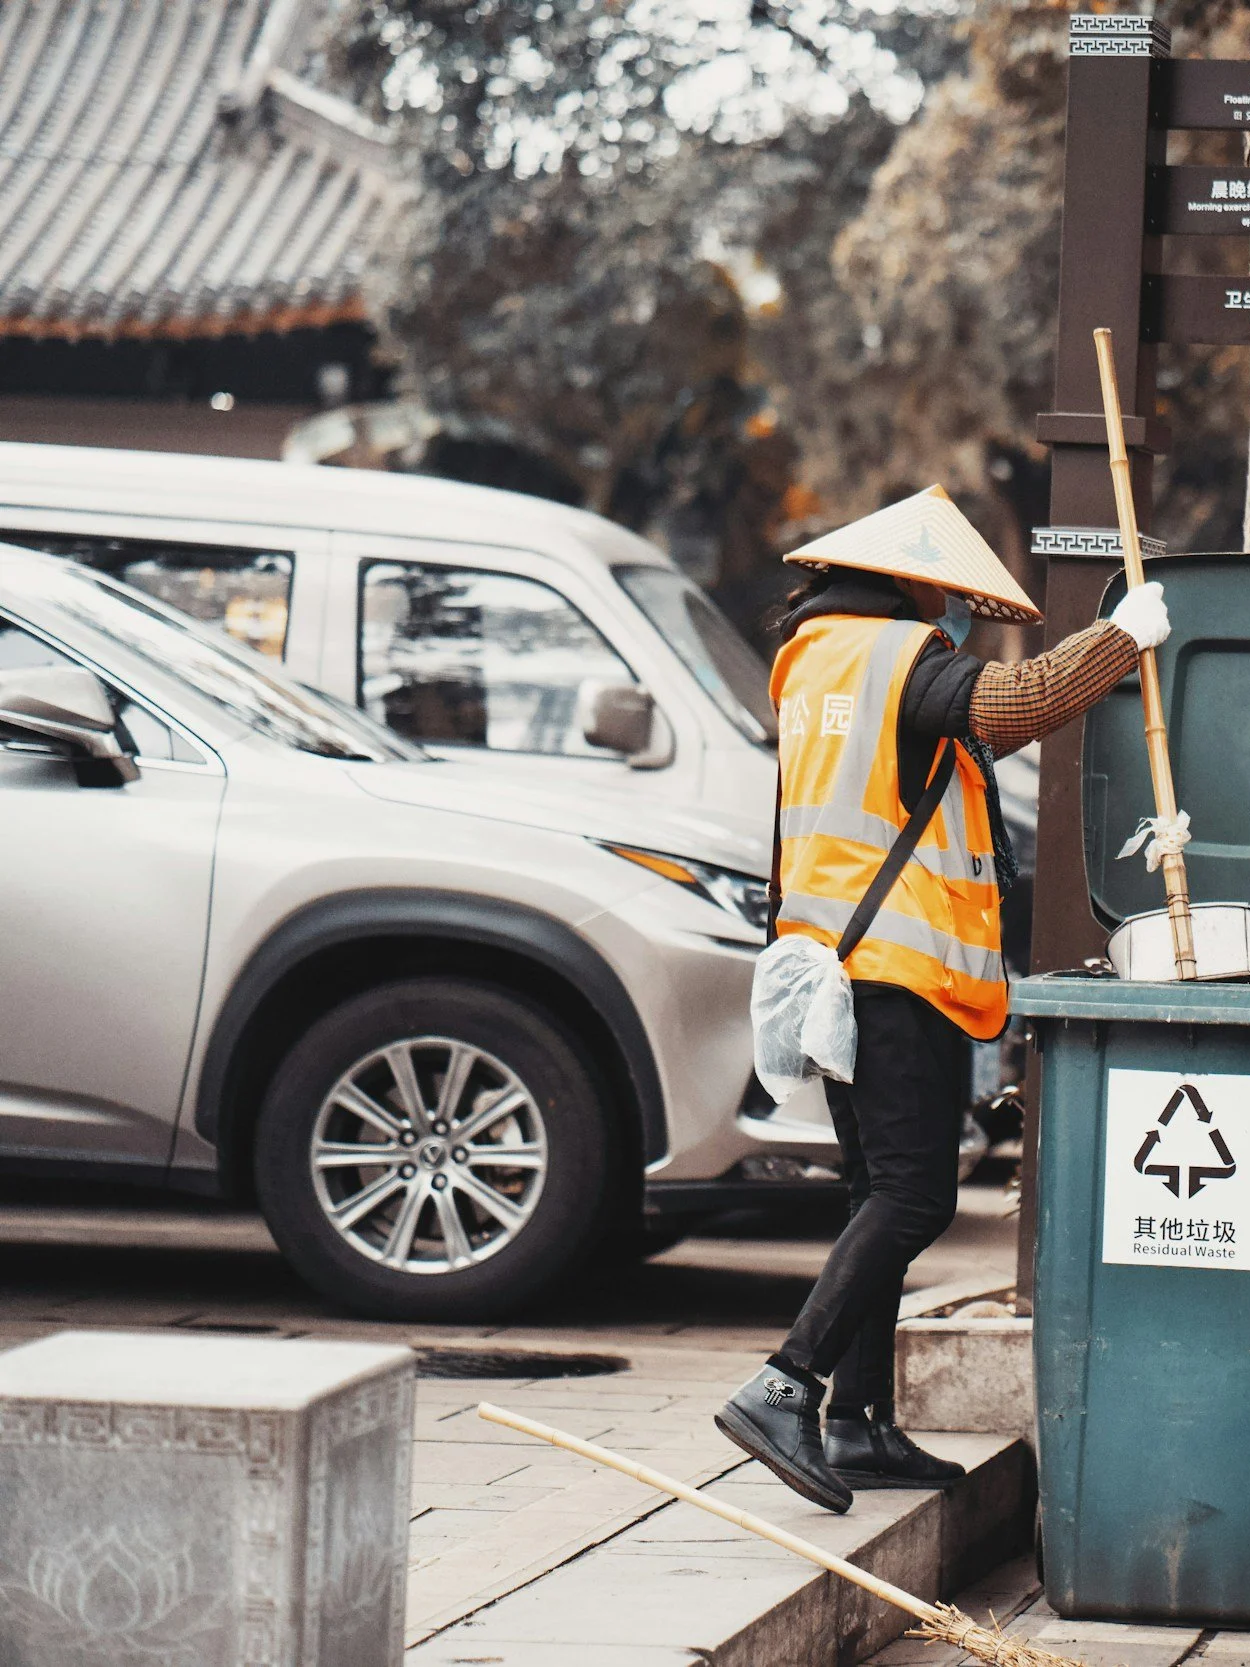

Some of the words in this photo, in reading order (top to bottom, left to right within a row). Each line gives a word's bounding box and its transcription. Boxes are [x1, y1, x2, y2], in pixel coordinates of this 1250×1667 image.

[1187, 202, 1223, 213] Morning
[1134, 1216, 1236, 1243] 其他垃圾
[1133, 1243, 1192, 1256] Residual
[1195, 1245, 1236, 1259] Waste
